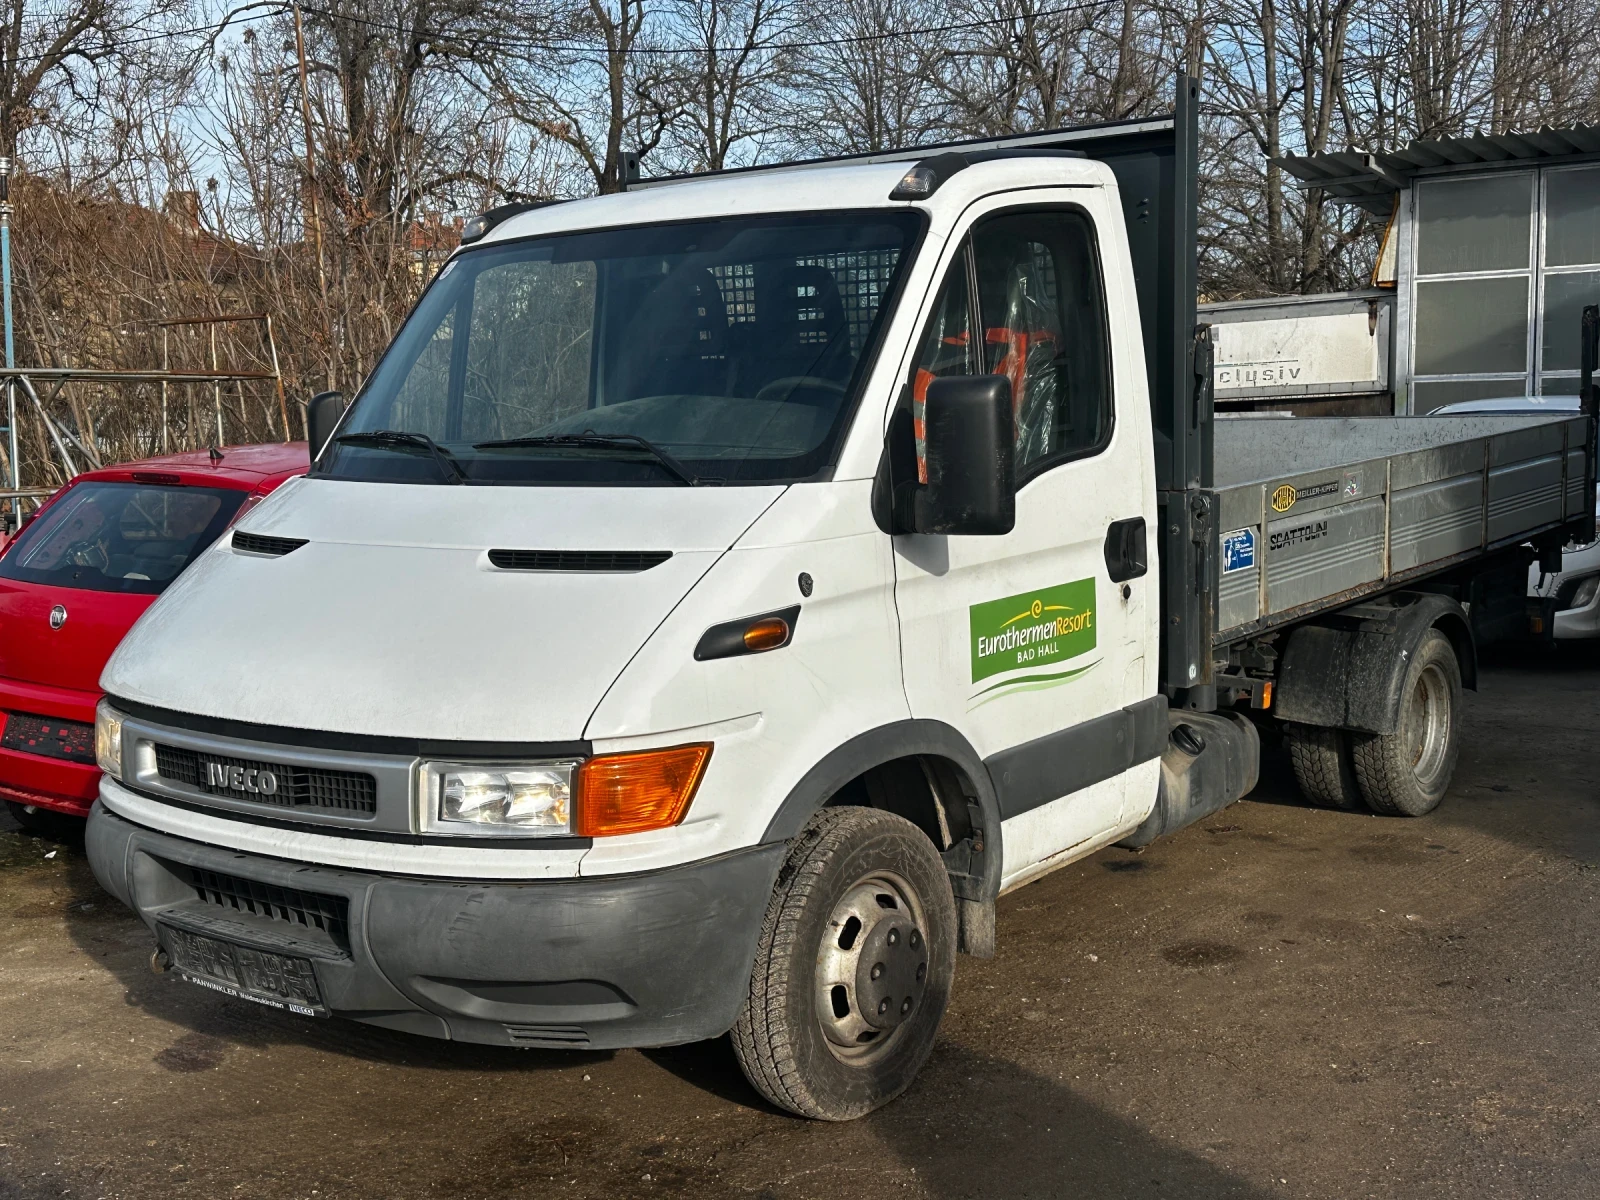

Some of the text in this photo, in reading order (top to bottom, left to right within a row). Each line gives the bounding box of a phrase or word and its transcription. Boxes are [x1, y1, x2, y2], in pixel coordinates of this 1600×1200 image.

[1017, 641, 1059, 663] BAD HALL
[207, 762, 277, 795] IVECO
